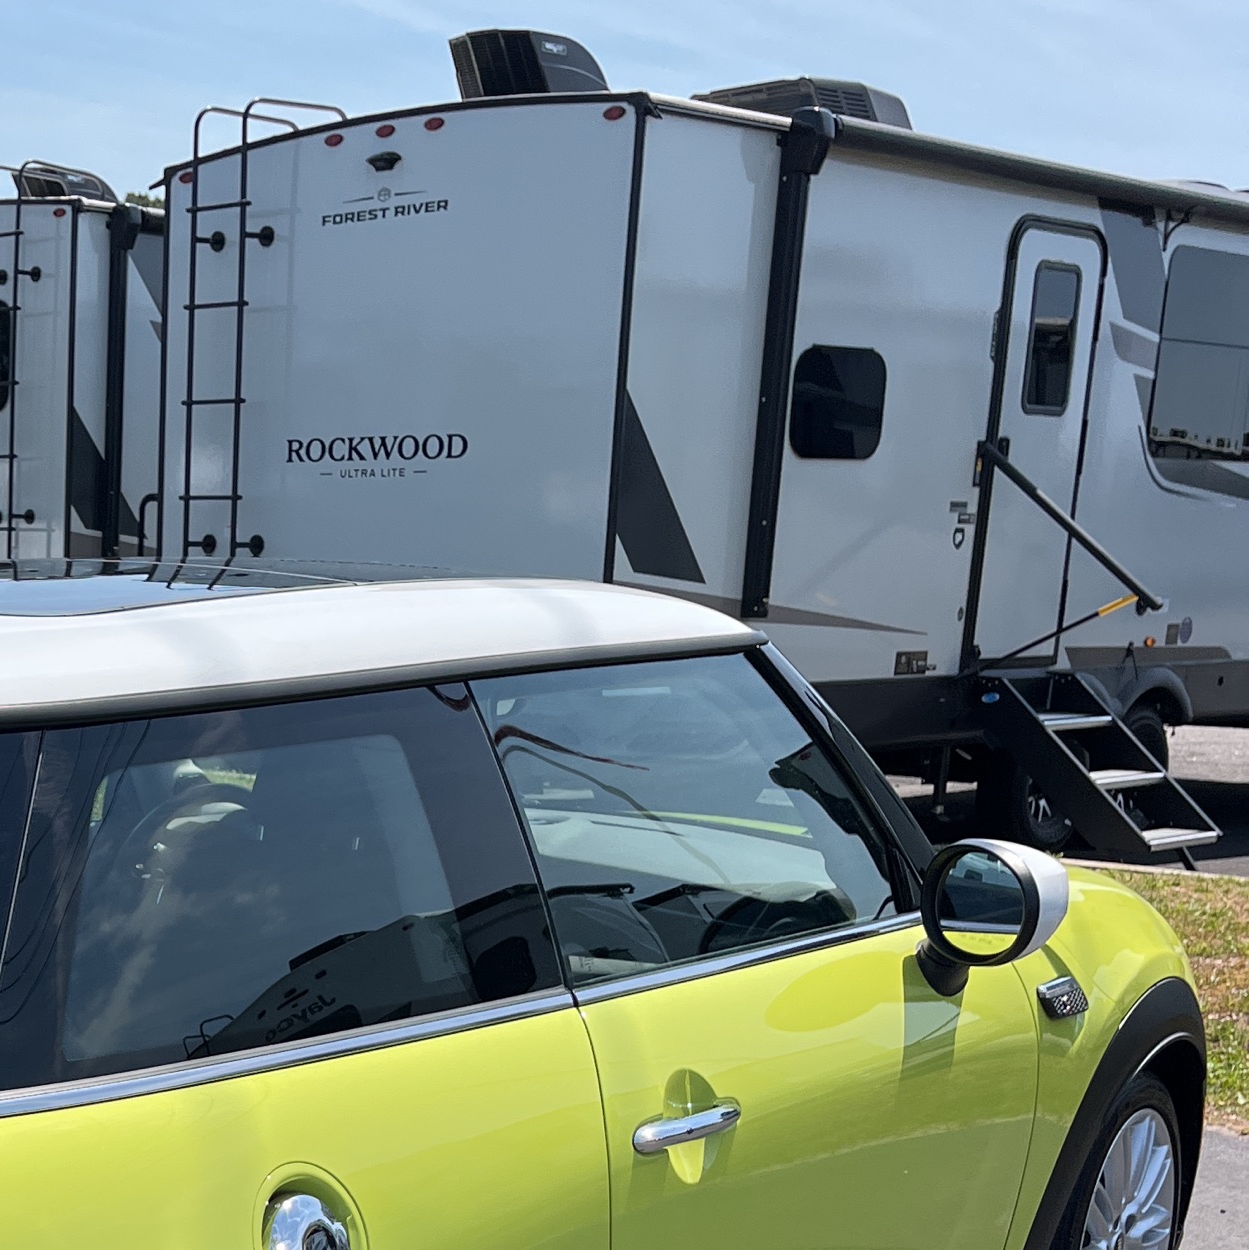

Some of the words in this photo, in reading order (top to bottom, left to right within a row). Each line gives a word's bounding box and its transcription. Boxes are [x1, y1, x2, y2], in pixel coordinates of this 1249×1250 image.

[322, 207, 390, 226] FOREST
[394, 199, 449, 217] RIVER
[286, 434, 469, 463] ROCKWOOD
[340, 469, 376, 478] ULTRA
[380, 468, 406, 477] LITE
